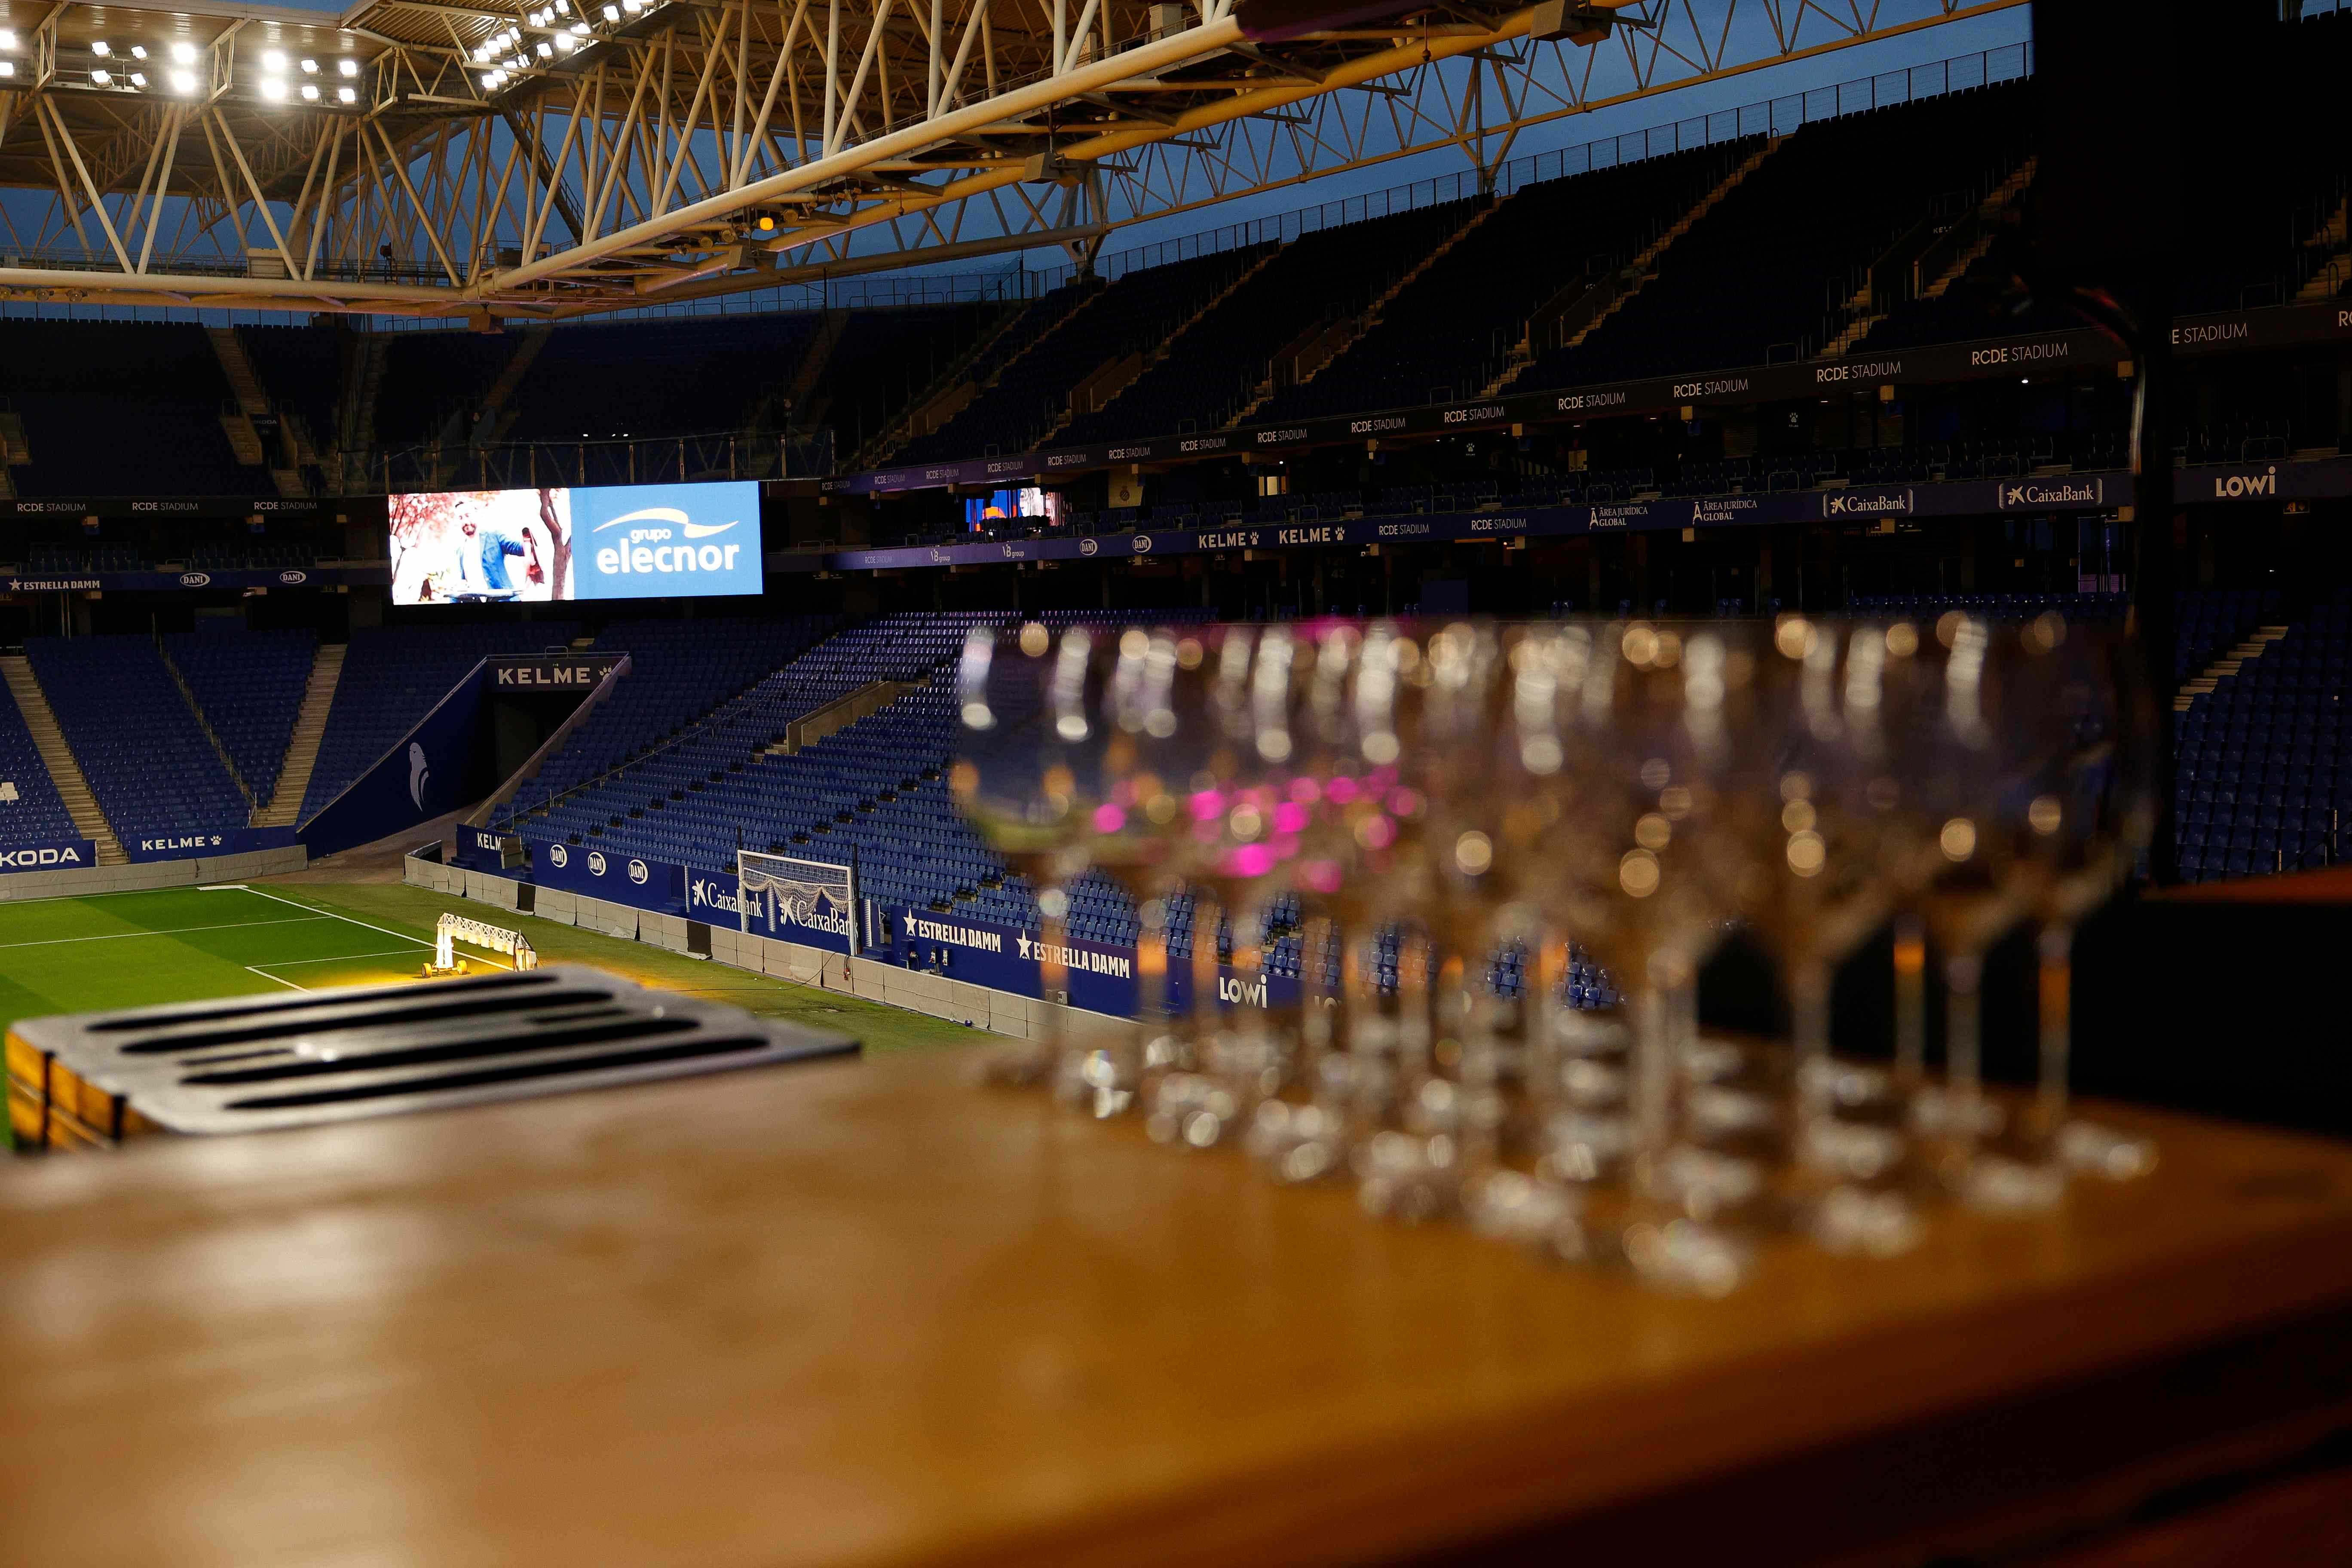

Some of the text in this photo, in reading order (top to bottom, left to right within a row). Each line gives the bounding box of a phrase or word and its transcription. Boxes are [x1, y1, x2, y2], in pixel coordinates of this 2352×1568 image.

[2184, 323, 2247, 343] STADIUM
[1972, 343, 2067, 365] RCDE STADIUM
[1817, 361, 1901, 382] RCDE STADIUM
[1674, 379, 1748, 397] RCDE STADIUM
[1559, 392, 1625, 410] RCDE STADIUM
[1445, 406, 1504, 423] RCDE STADIUM
[1352, 418, 1405, 432] RCDE STADIUM
[1258, 429, 1307, 442] RCDE STADIUM
[1181, 438, 1225, 451] RCDE STADIUM
[1109, 447, 1150, 459] RCDE STADIUM
[988, 461, 1023, 472] RCDE STADIUM
[1048, 454, 1086, 466] RCDE STADIUM
[875, 475, 886, 484] RCDE
[926, 469, 959, 479] RCDE STADIUM
[822, 482, 833, 490] RCDE
[2027, 485, 2094, 502] CaixaBank
[1724, 499, 1757, 511] JURÍDICA
[1848, 495, 1905, 511] CaixaBank
[1618, 506, 1648, 517] JURÍDICA
[1704, 512, 1733, 521] GLOBAL
[1472, 518, 1526, 530] RCDE STADIUM
[1599, 518, 1626, 526] GLOBAL
[630, 529, 671, 543] grupo
[1280, 527, 1330, 544] KELME
[1379, 524, 1429, 535] RCDE STADIUM
[1135, 540, 1147, 548] DANI
[1199, 533, 1246, 548] KELME
[1081, 543, 1093, 552] DANI
[597, 538, 739, 574] elecnor
[939, 555, 950, 563] group
[184, 576, 203, 585] DANI
[283, 573, 301, 582] DANI
[499, 668, 590, 684] KELME
[142, 837, 205, 850] KELME
[478, 832, 505, 851] KELM
[551, 850, 564, 862] DANI
[589, 857, 602, 871] DANI
[630, 864, 643, 879] DANI
[919, 920, 1001, 952] ESTRELLA DAMM
[1034, 942, 1130, 978] ESTRELLA DAMM
